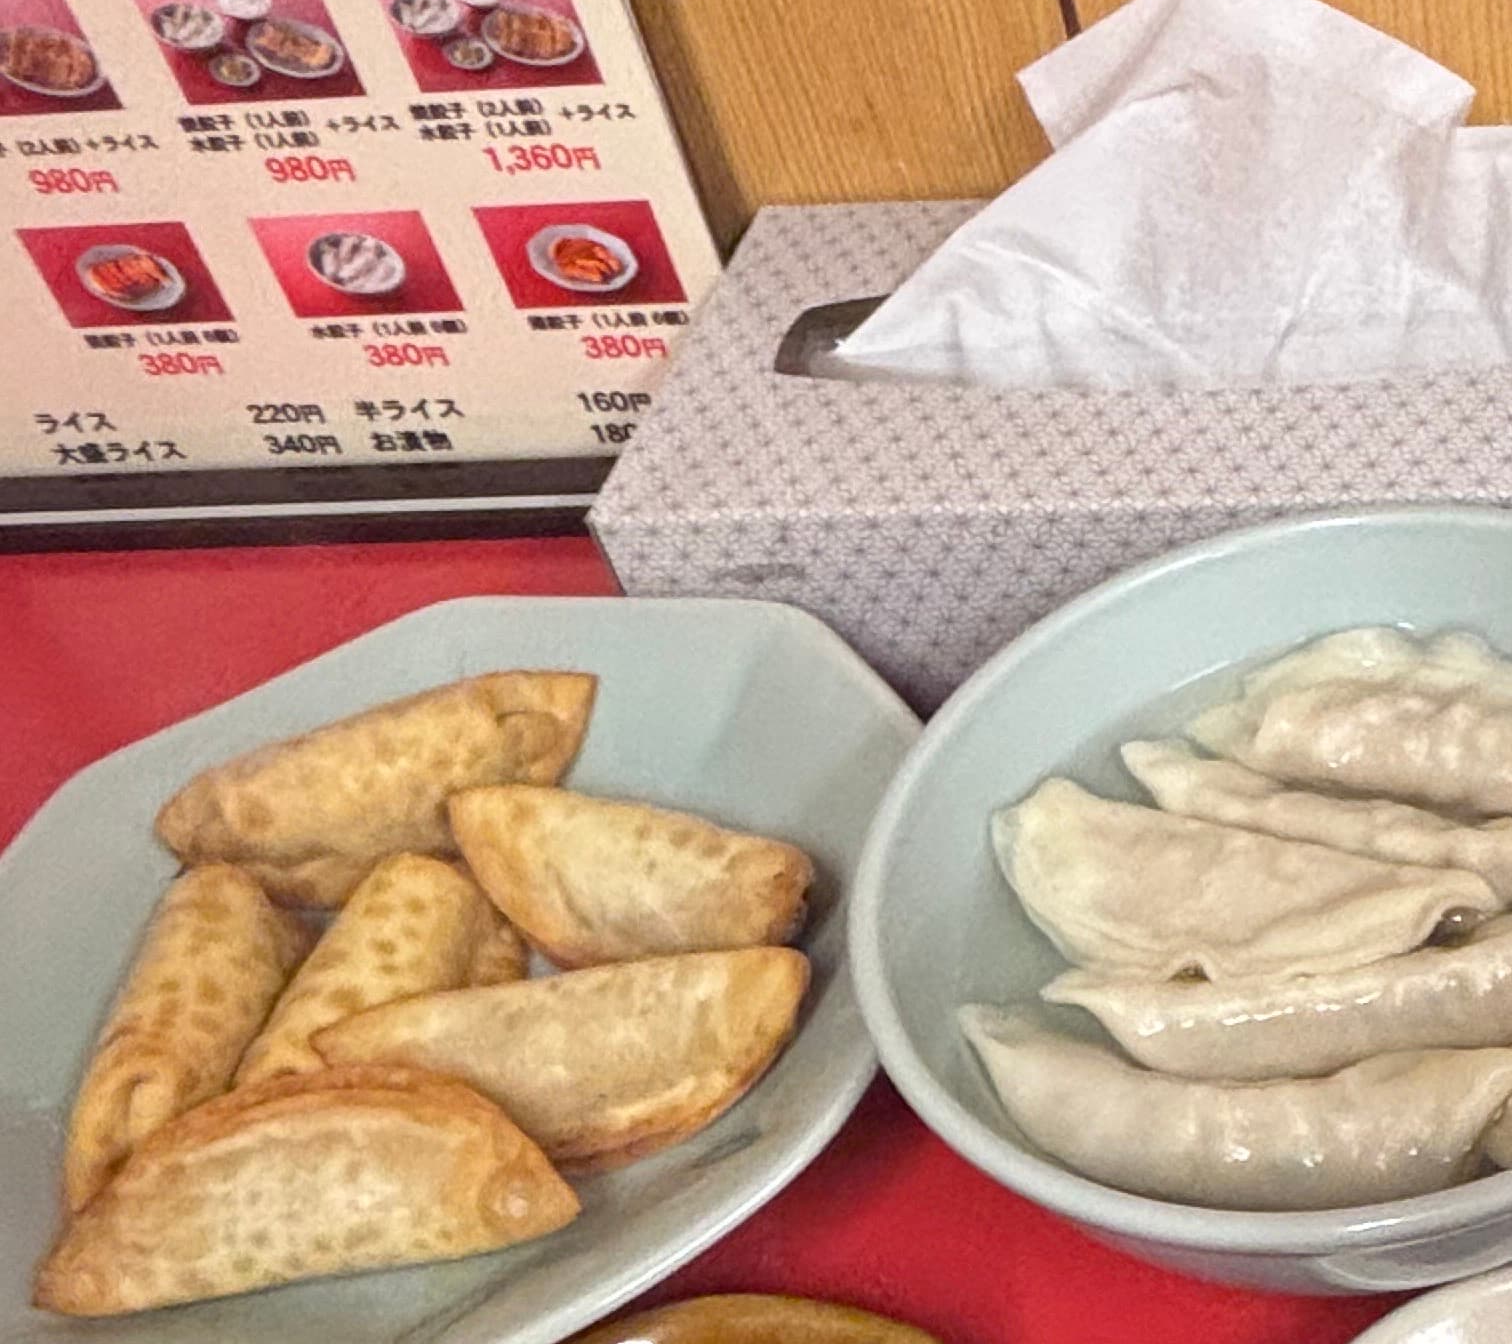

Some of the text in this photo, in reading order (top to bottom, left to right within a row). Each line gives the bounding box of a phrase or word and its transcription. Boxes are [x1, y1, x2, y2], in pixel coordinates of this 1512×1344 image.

[265, 155, 357, 183] 980円
[483, 144, 602, 175] 1,360円
[29, 168, 120, 194] 980円
[363, 343, 450, 367] 380円
[581, 335, 668, 358] 380円
[138, 353, 225, 375] 380円
[34, 404, 326, 434] ライス 220円
[354, 398, 465, 422] 半ライス
[263, 434, 343, 454] 340円
